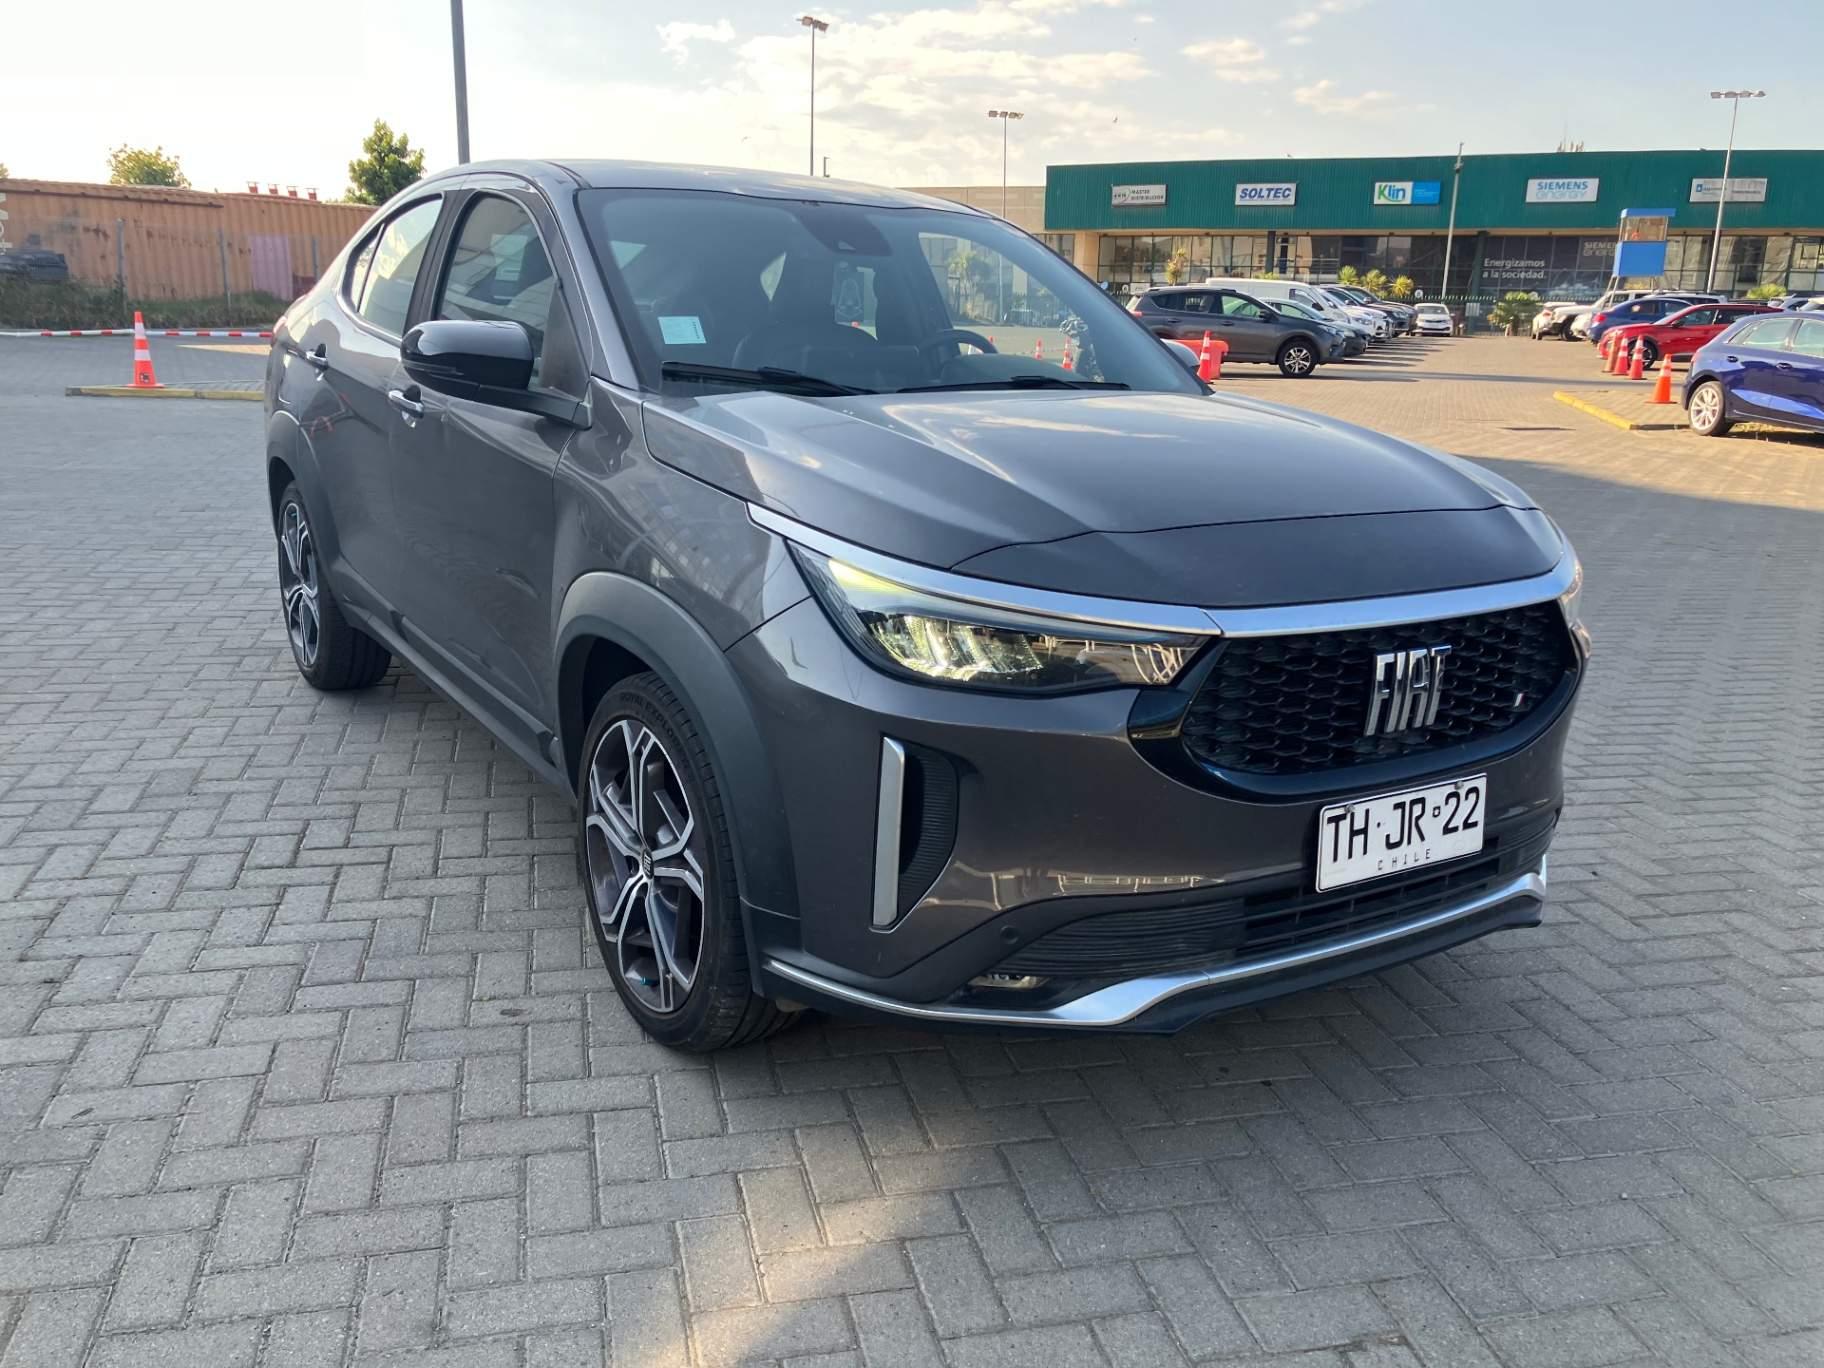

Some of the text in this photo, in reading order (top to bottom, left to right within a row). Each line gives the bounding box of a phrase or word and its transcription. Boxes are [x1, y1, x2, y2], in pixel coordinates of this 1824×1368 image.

[1536, 181, 1589, 190] SIEMENS
[1240, 188, 1292, 199] SOLTEC
[1377, 183, 1407, 201] Klin
[1484, 258, 1545, 270] Energizamos
[1490, 269, 1500, 279] la
[1501, 270, 1547, 279] sociedad.
[1364, 645, 1452, 736] FIAT
[1377, 848, 1432, 871] CHILE
